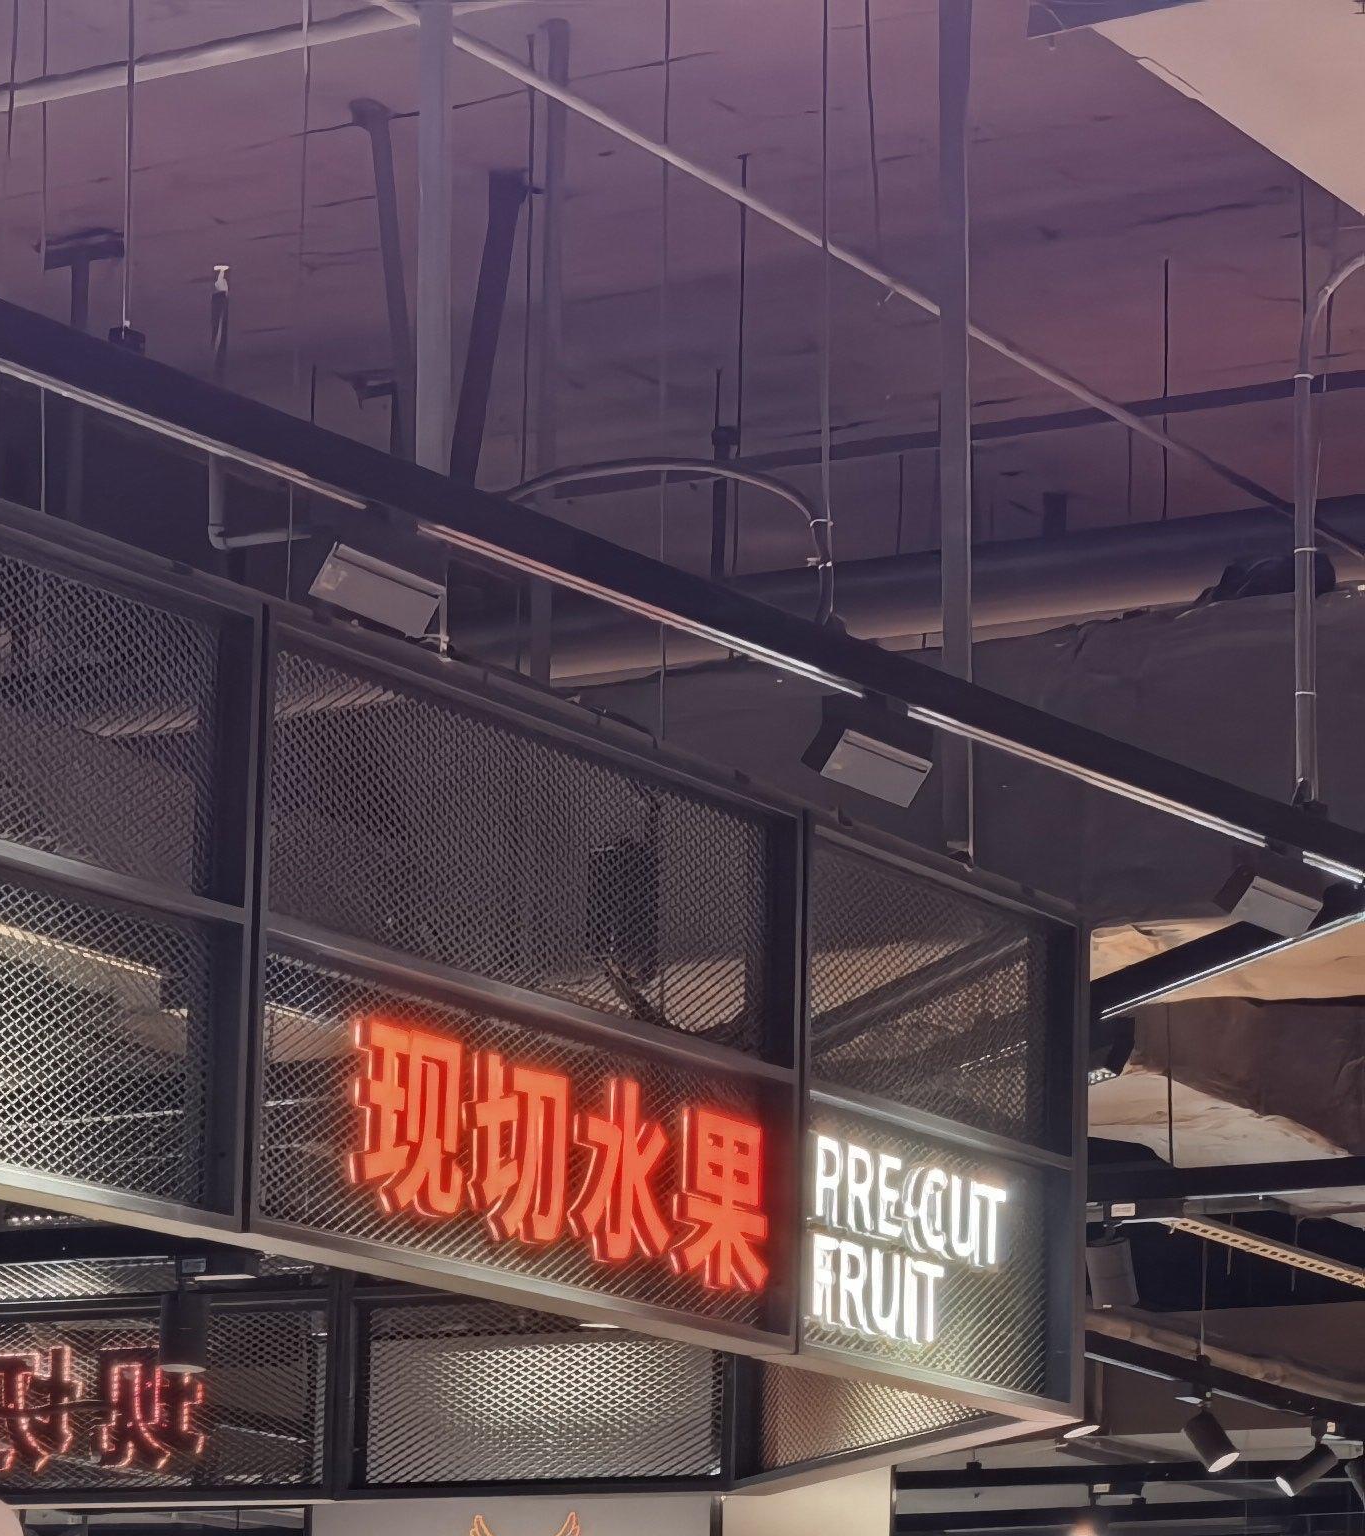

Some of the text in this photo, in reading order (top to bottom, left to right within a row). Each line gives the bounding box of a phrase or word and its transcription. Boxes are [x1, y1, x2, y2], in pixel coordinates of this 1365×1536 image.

[350, 1019, 768, 1290] 现切水果
[810, 1131, 1007, 1270] PRE-CUT
[809, 1233, 944, 1344] FRUIT
